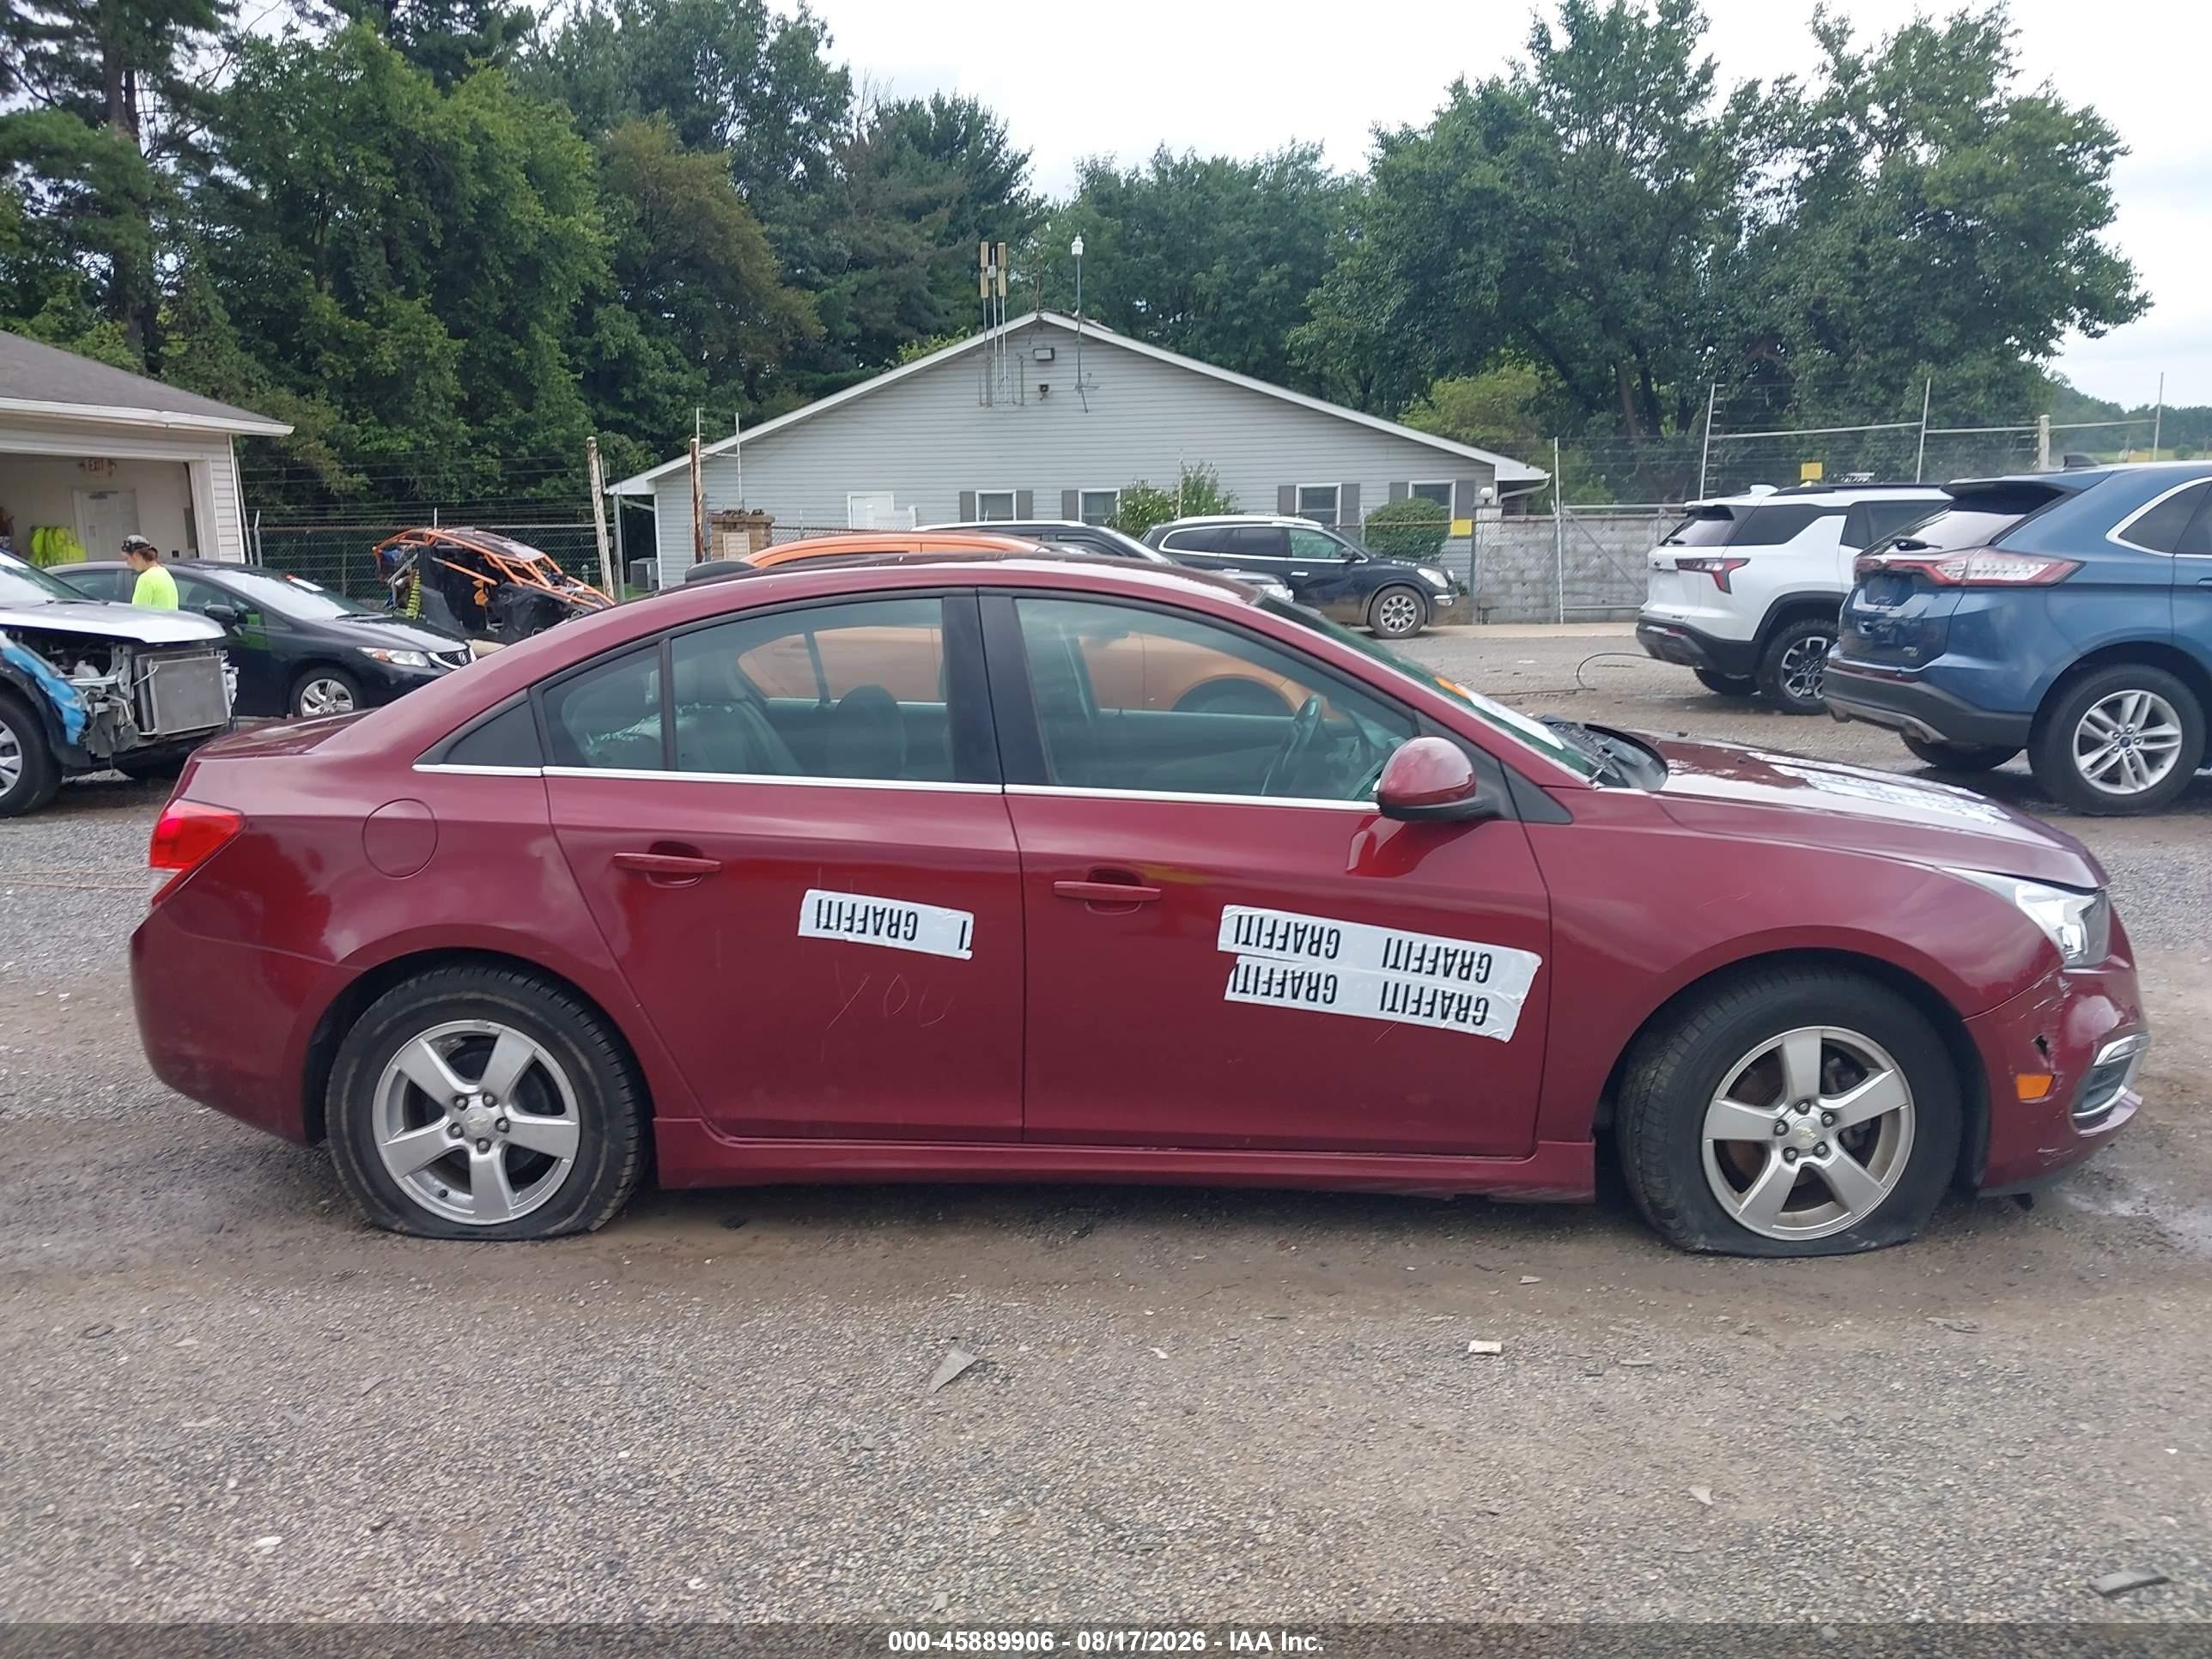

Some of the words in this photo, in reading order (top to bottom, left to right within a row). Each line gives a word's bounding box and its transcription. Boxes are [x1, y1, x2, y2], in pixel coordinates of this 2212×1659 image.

[815, 899, 919, 941] GRAFFITI
[1234, 915, 1340, 959] GRAFFITI
[1382, 937, 1492, 984] GRAFFITI
[1232, 963, 1338, 1005] GRAFFITI
[1379, 981, 1489, 1027] GRAFFITI
